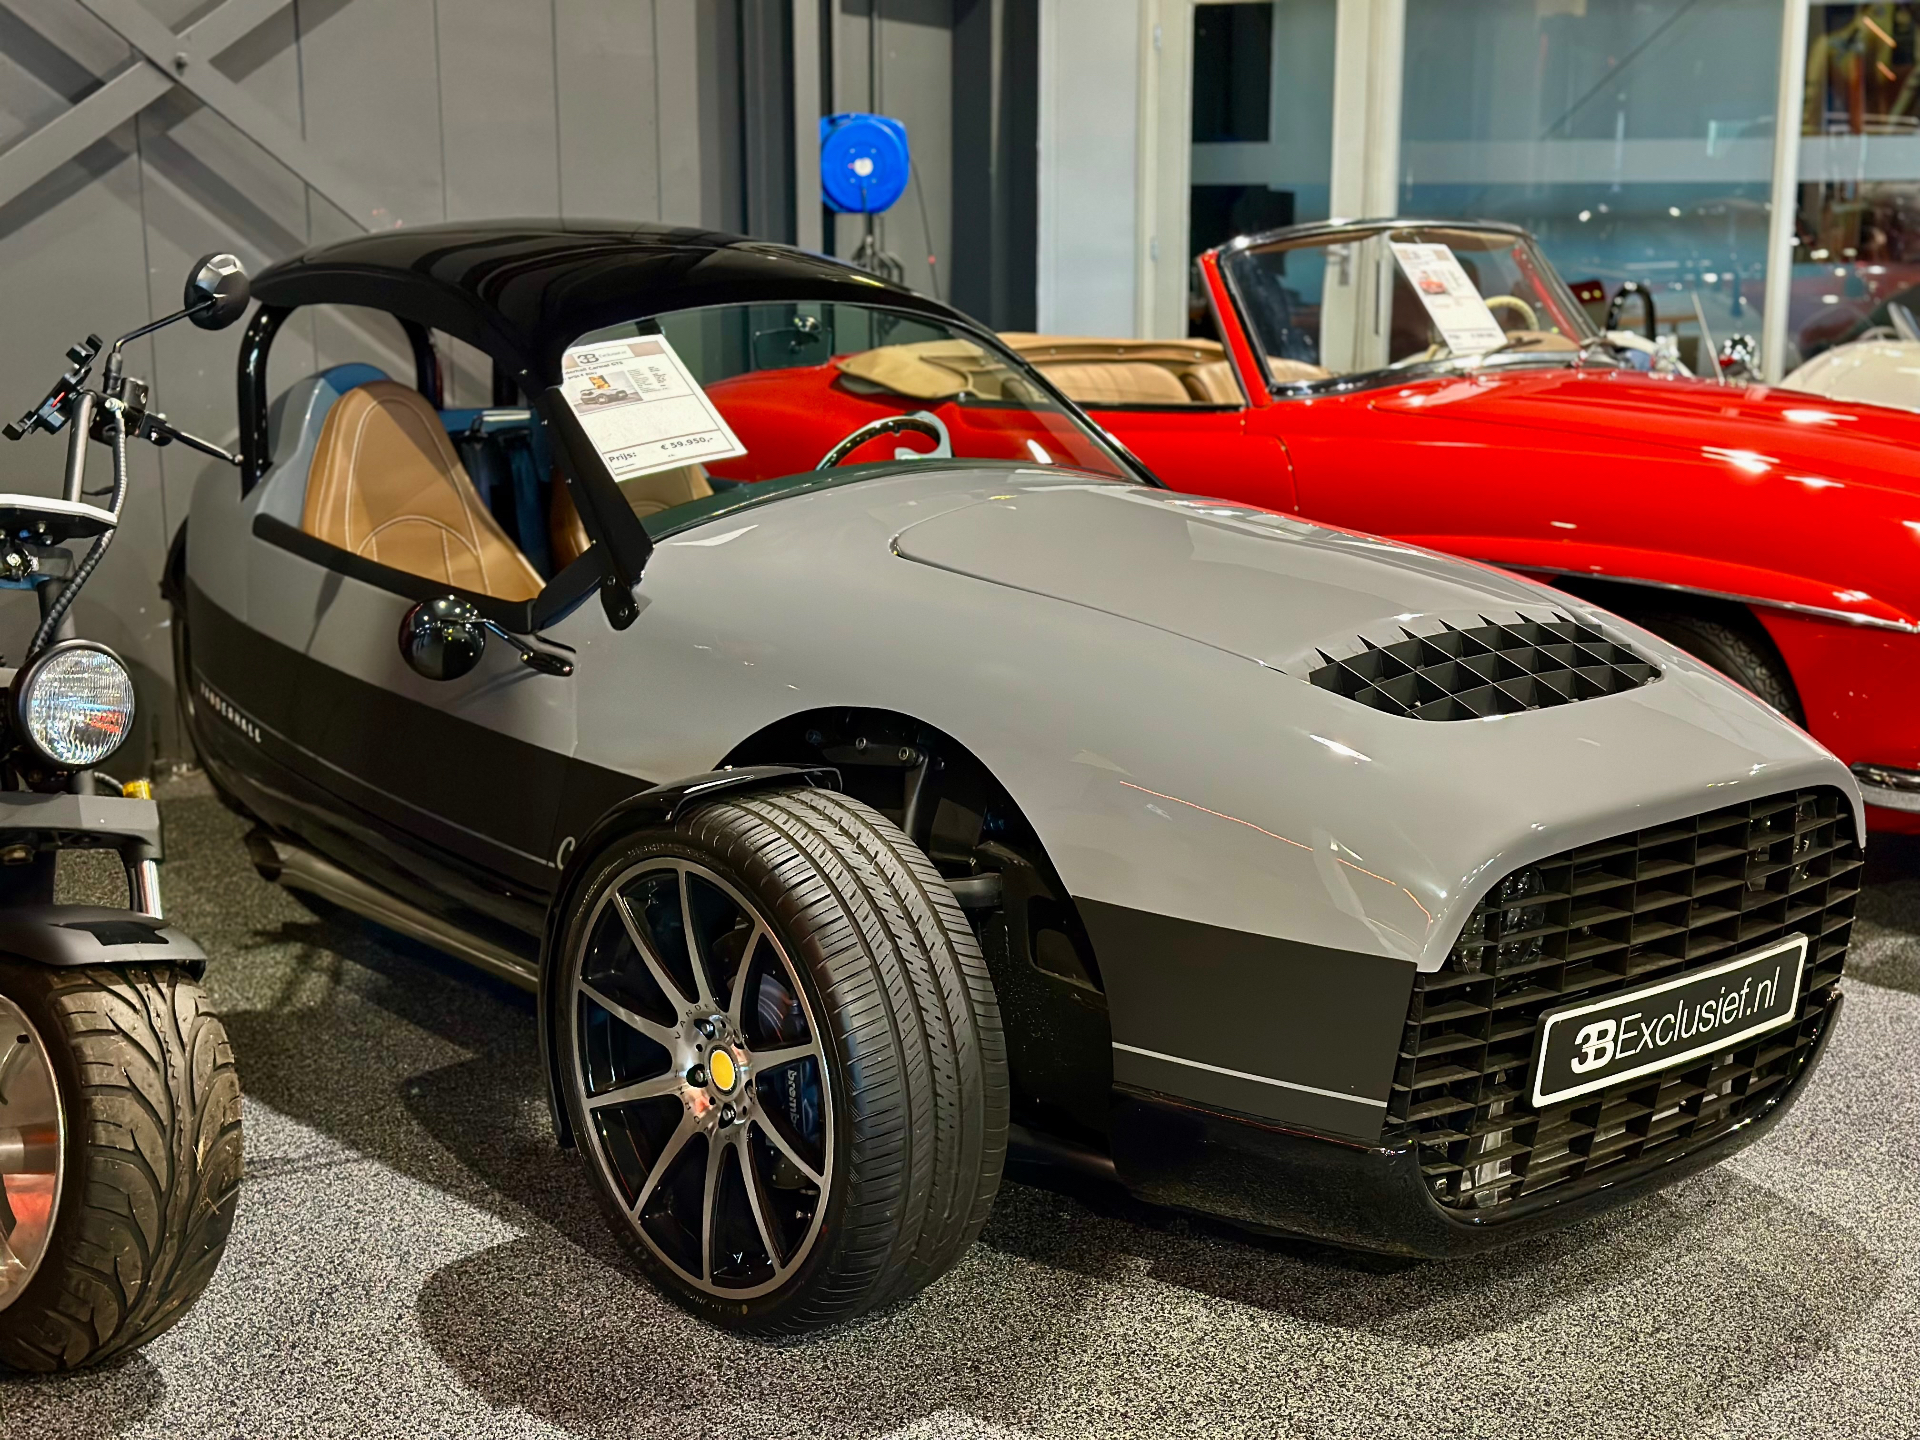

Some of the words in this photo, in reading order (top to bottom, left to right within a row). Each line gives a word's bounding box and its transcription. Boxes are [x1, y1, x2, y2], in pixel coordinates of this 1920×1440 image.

[608, 450, 637, 463] Prijs:
[660, 443, 668, 451] €
[670, 437, 713, 449] 59.950,-
[787, 1068, 799, 1130] bremb
